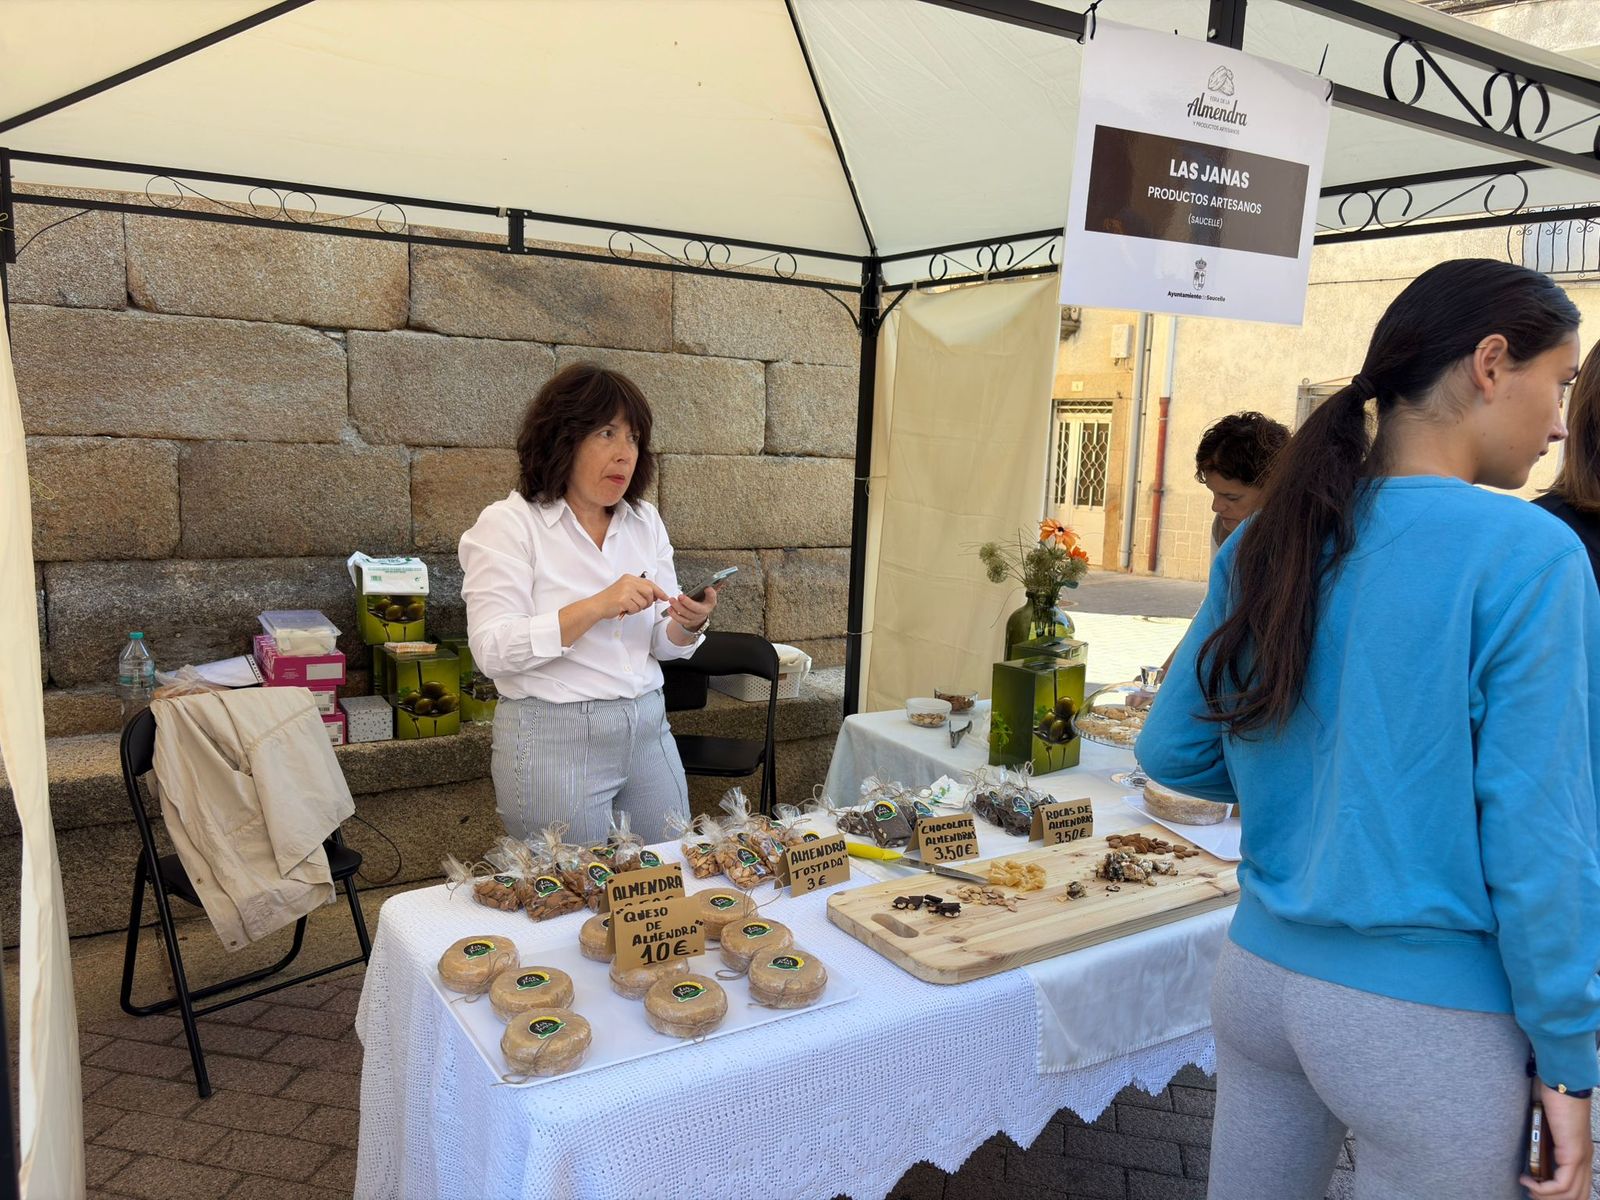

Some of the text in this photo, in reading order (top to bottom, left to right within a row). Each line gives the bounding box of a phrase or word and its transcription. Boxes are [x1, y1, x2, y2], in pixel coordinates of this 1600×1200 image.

[1187, 92, 1248, 126] Almendra
[1196, 121, 1219, 131] PRODUCTOS
[1169, 159, 1250, 189] LAS JANAS
[1147, 186, 1262, 214] PRODUCTOS ARTESANOS
[1188, 213, 1223, 229] (SAUCELLE)
[1167, 291, 1202, 300] Ayuntamiento
[1206, 294, 1226, 302] Saucelle
[1077, 804, 1092, 814] DE
[645, 920, 662, 932] DE
